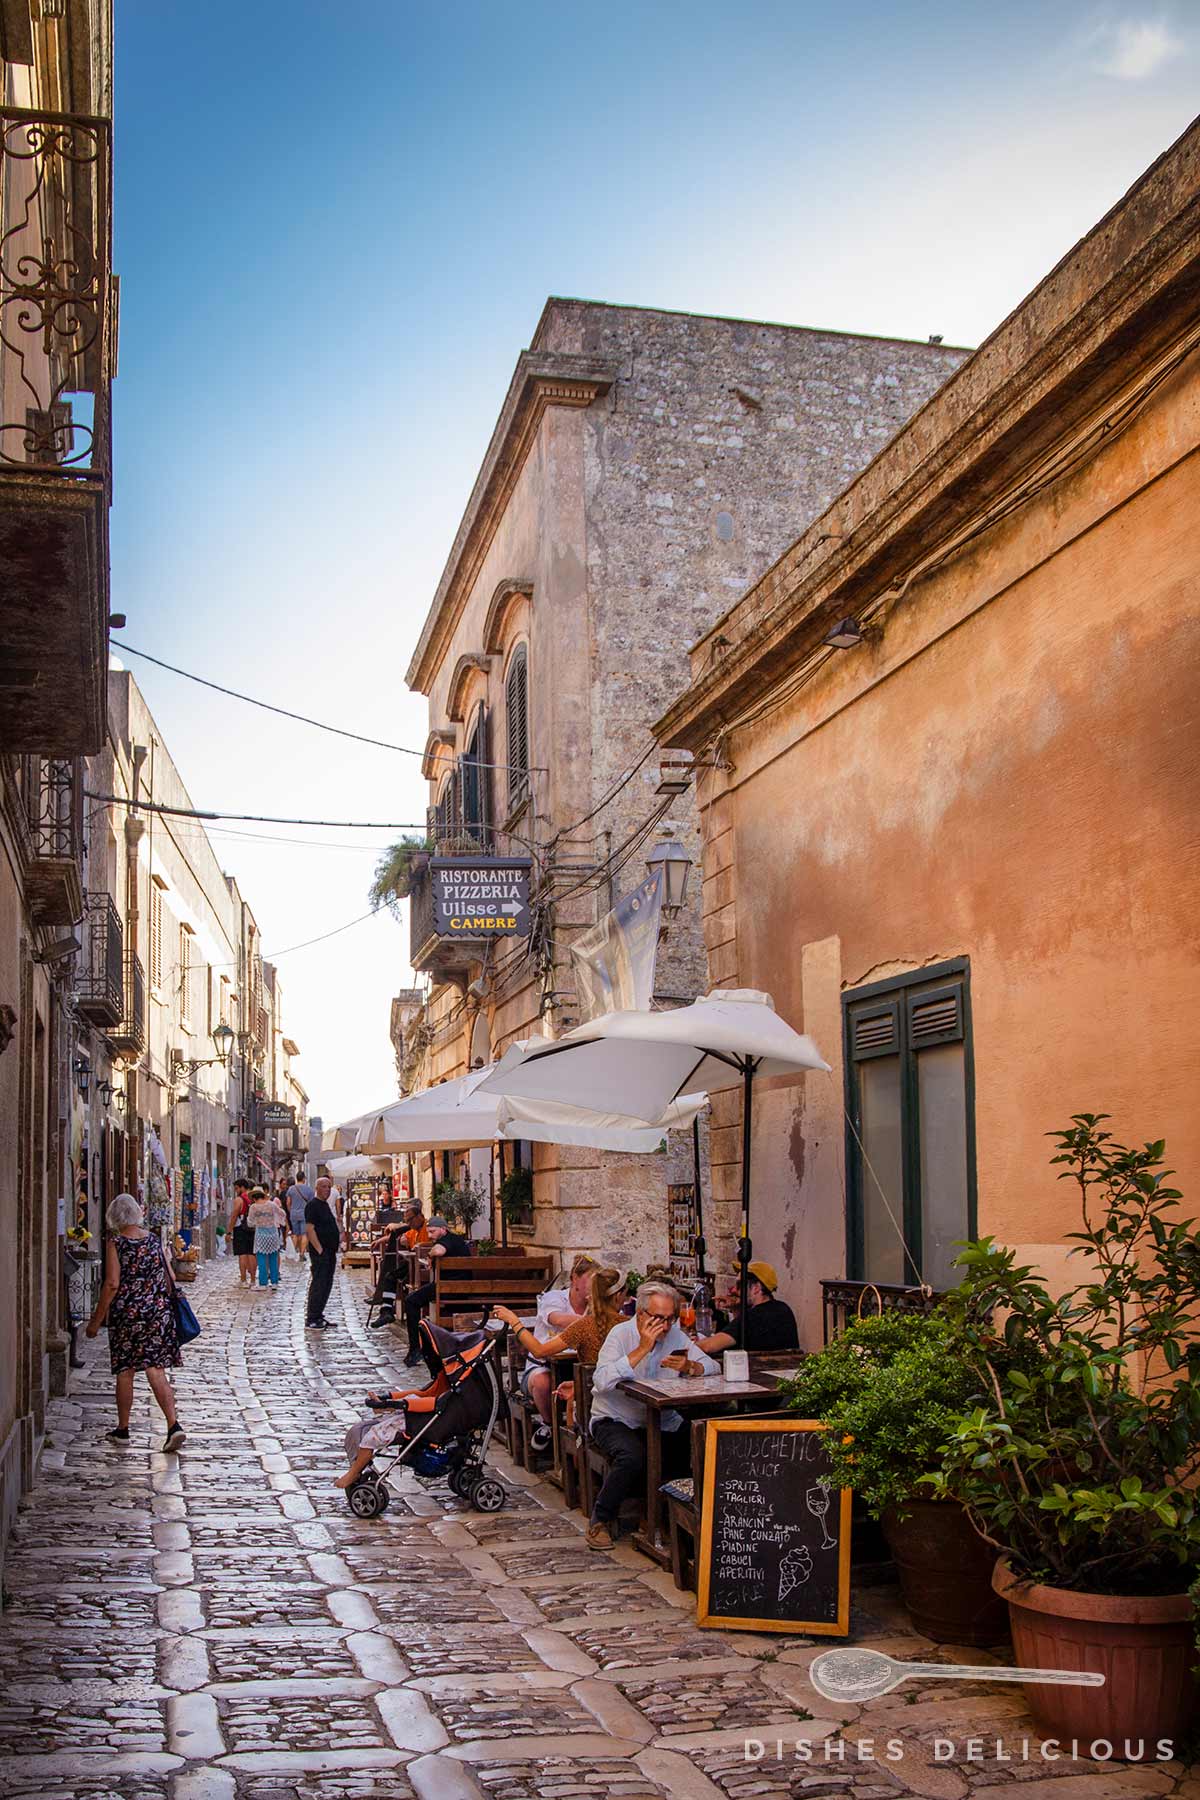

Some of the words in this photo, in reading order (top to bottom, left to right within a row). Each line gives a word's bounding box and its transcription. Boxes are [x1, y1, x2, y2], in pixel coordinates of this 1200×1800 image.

[440, 869, 523, 883] RISTORANTE
[443, 885, 521, 899] PIZZERIA
[441, 901, 497, 916] Ulisse
[450, 917, 517, 929] CAMERE
[722, 1527, 745, 1540] PANE
